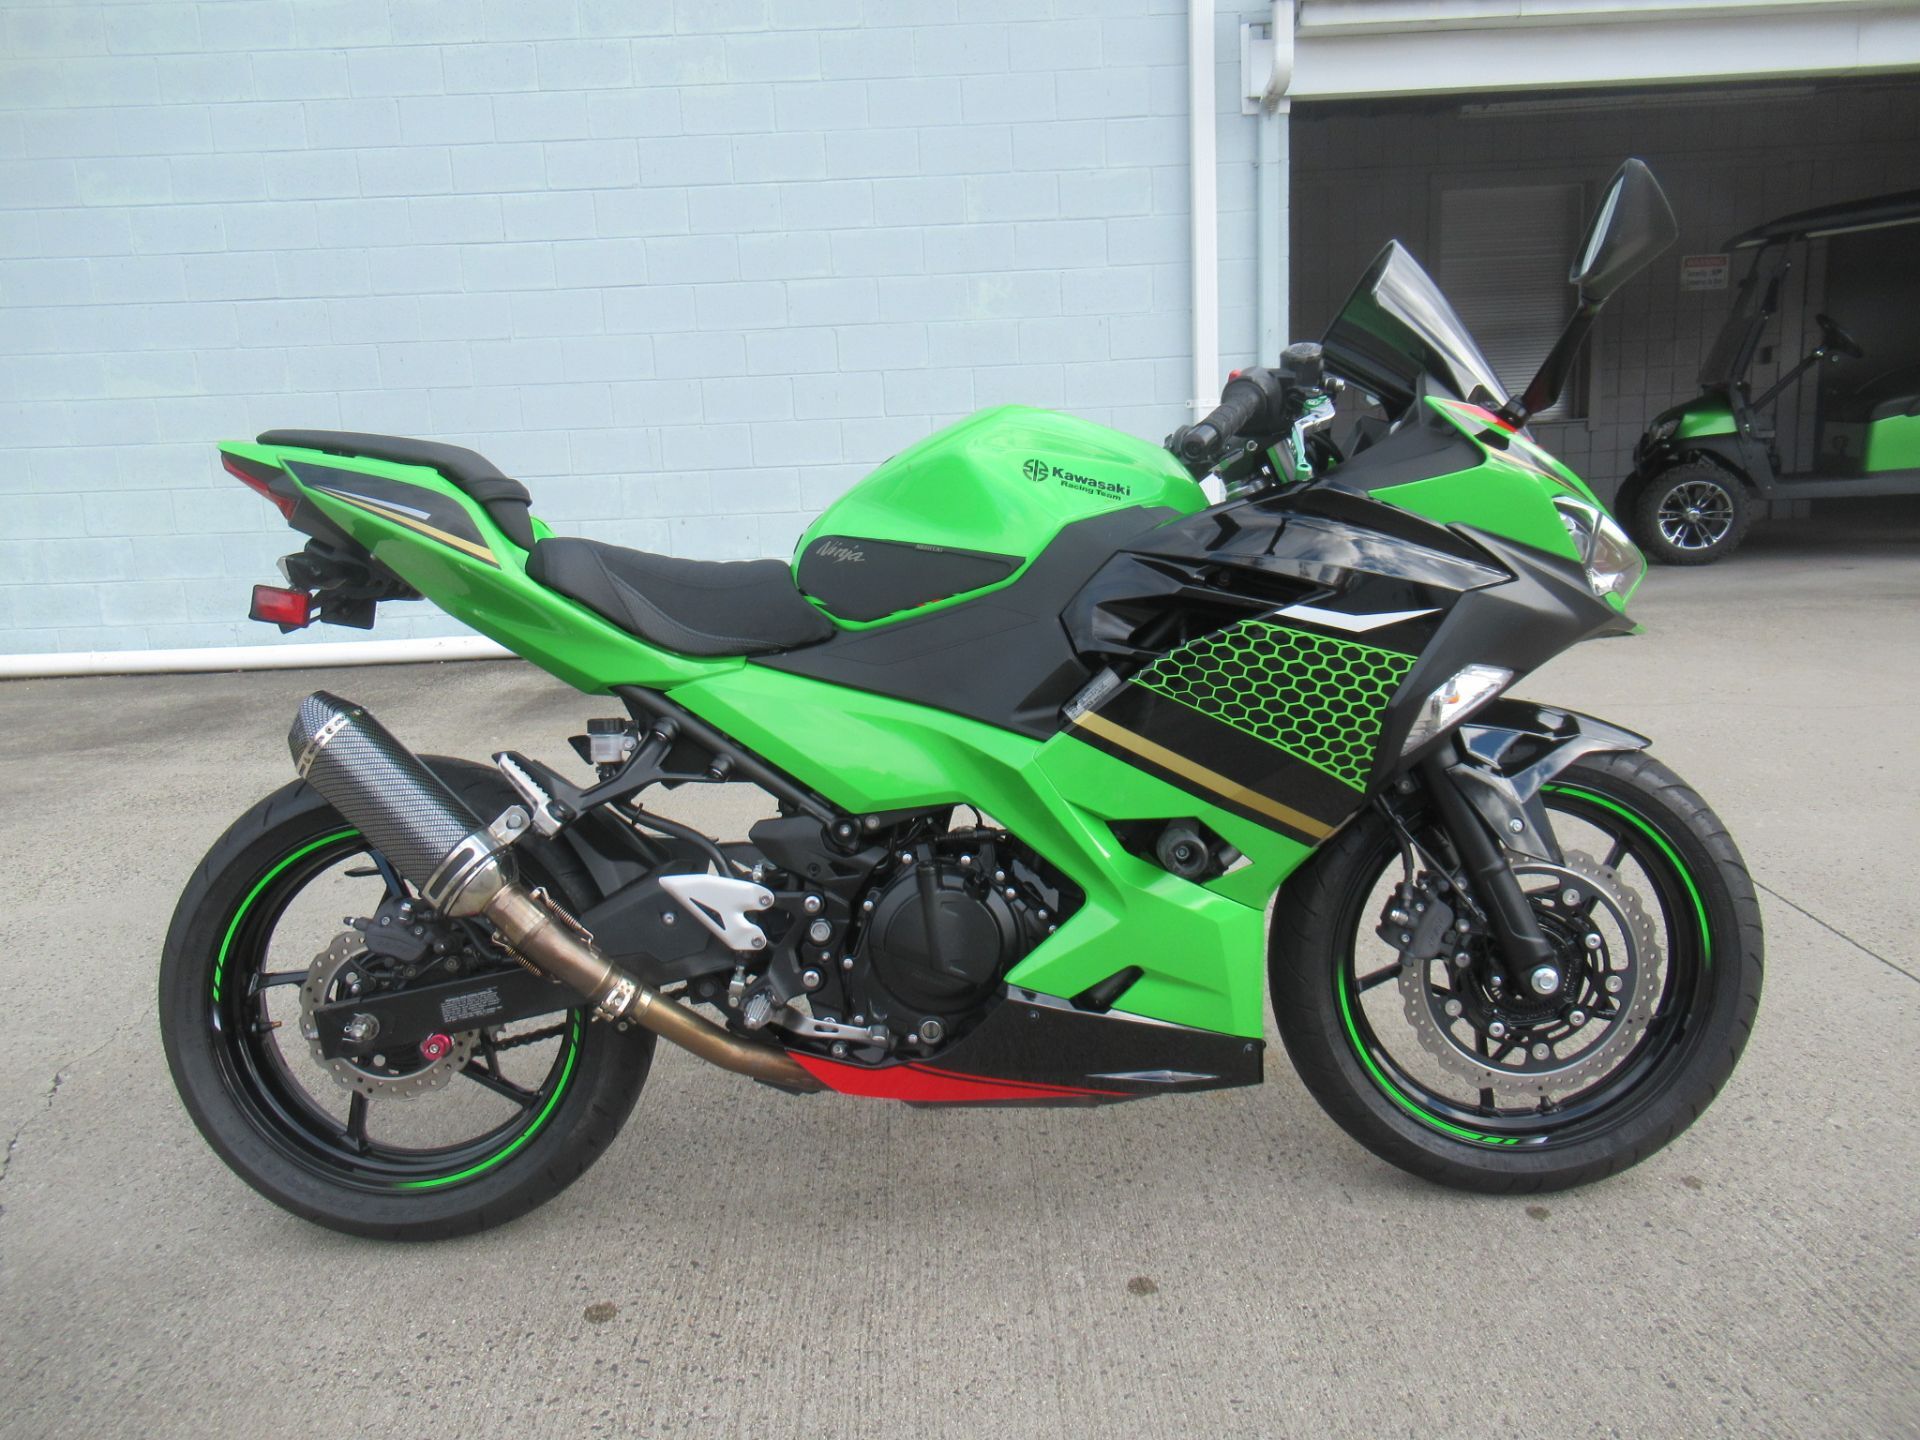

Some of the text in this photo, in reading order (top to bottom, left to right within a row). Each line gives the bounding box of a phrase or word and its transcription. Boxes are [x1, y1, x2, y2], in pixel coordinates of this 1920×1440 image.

[1052, 466, 1131, 496] Kawasaki
[1060, 480, 1122, 501] Racing Team
[815, 540, 866, 564] Ninja
